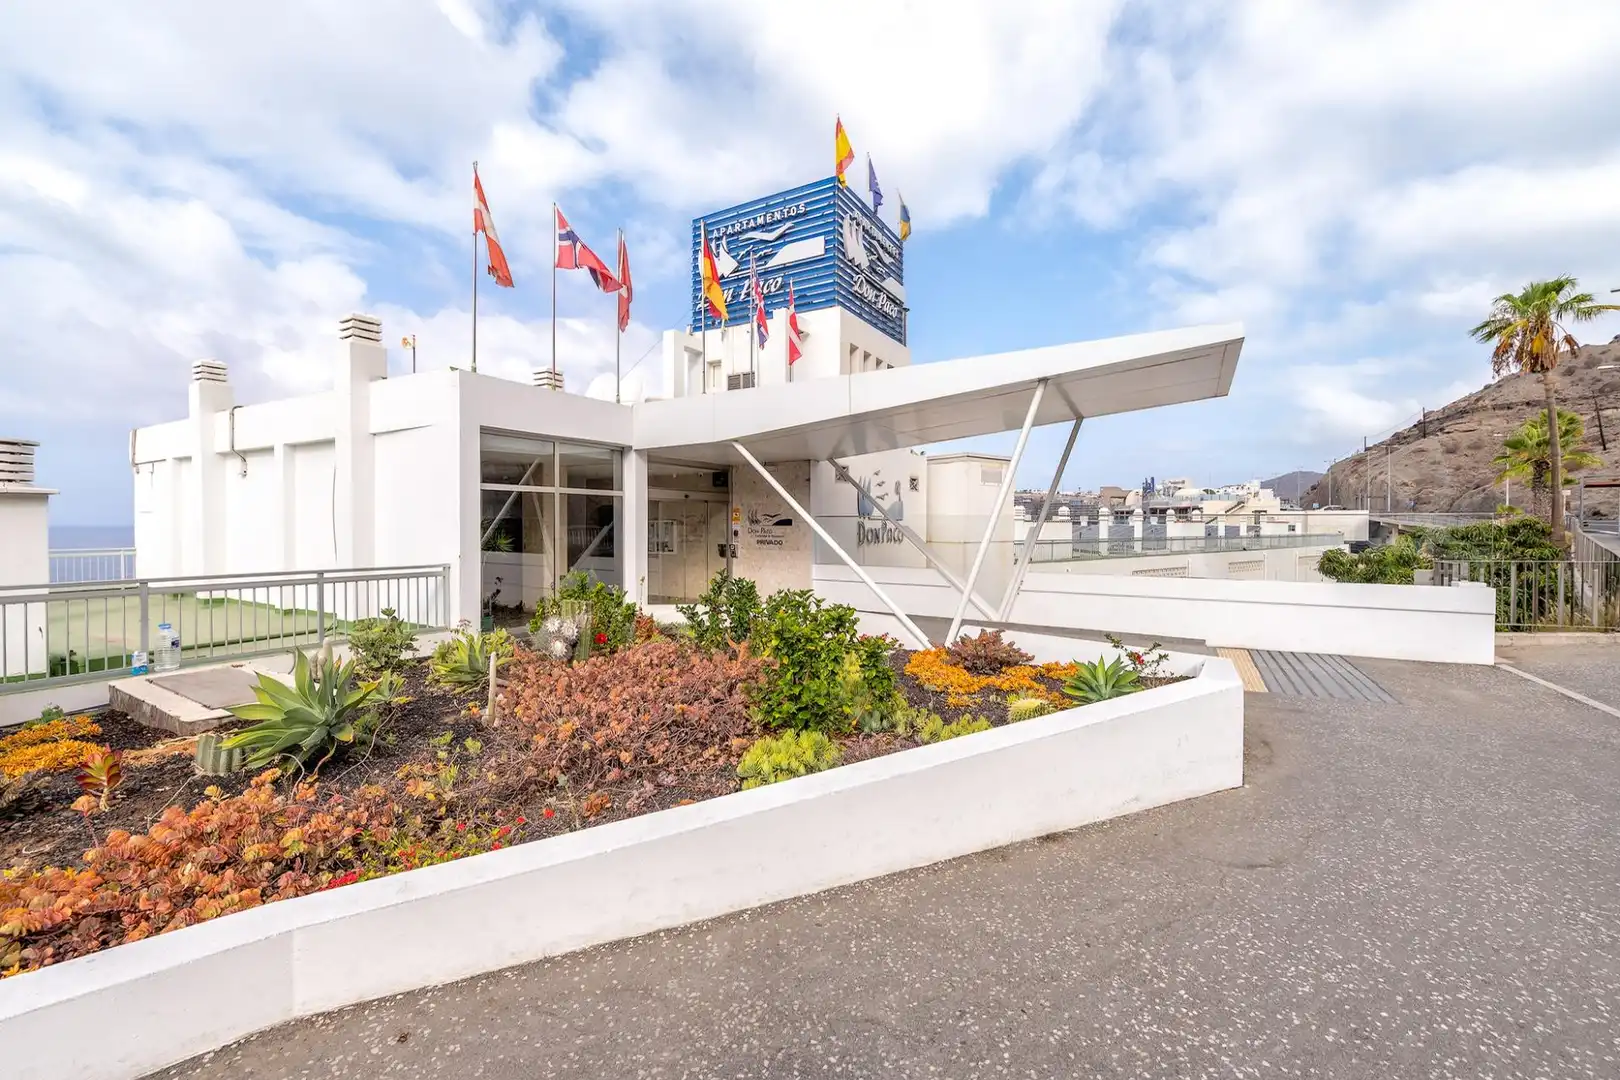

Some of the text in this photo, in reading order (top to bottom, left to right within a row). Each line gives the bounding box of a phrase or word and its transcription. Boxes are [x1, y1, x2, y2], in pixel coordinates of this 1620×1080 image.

[712, 203, 807, 238] APARTAMENTOS
[853, 274, 898, 318] Don Paco
